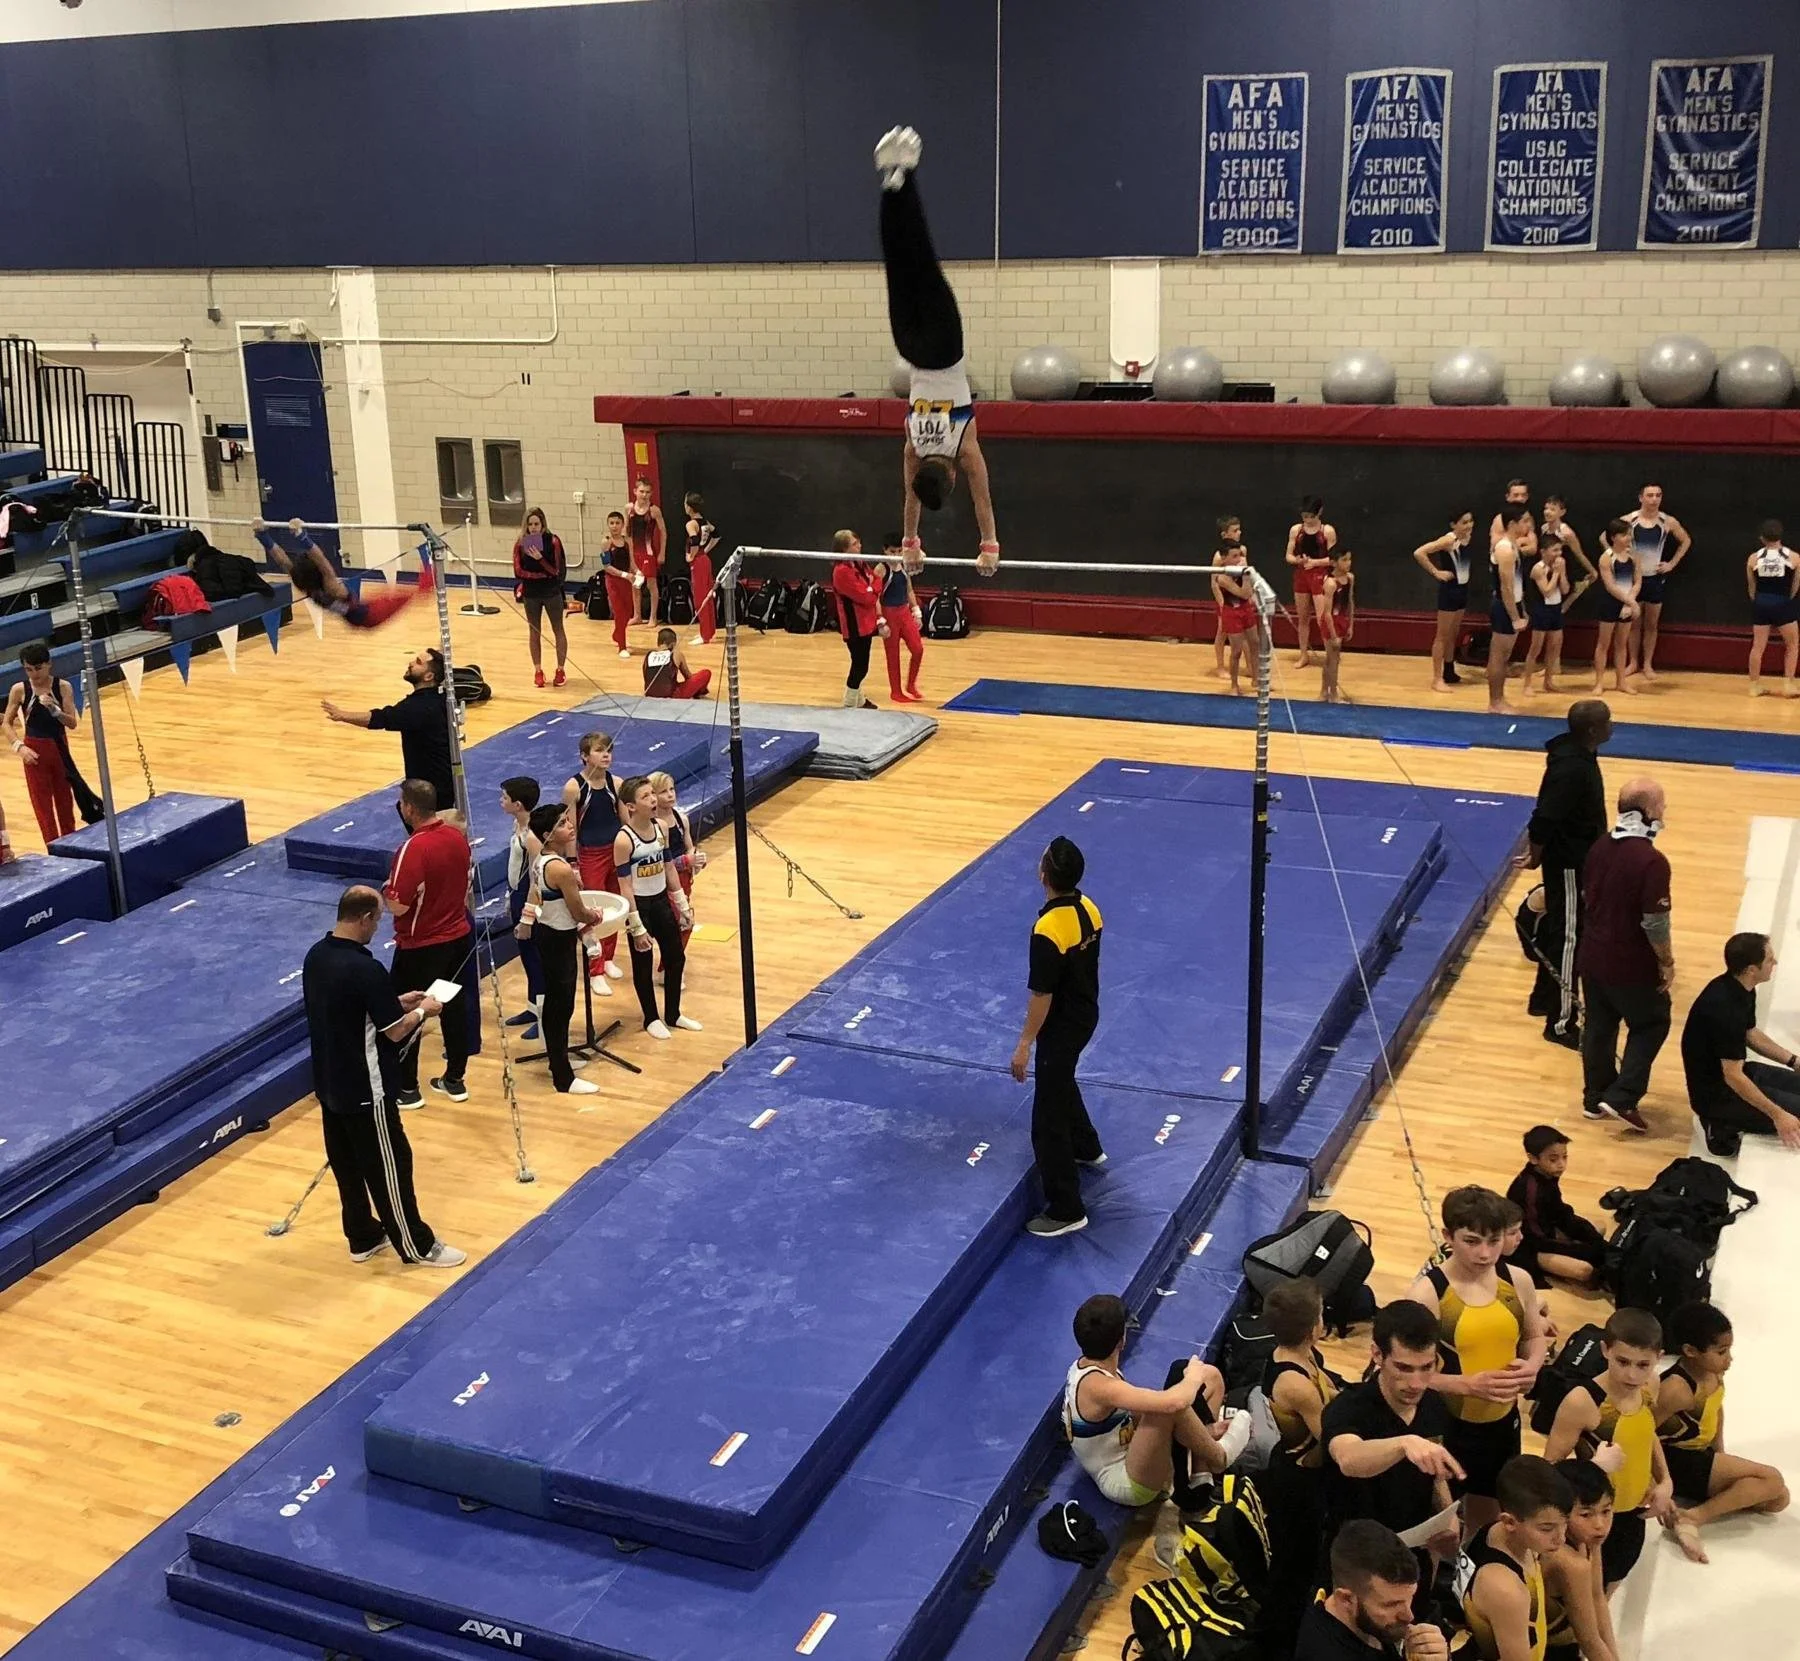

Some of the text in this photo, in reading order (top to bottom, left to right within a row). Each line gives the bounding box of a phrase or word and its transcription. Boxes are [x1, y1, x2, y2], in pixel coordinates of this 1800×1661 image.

[1378, 76, 1419, 100] AFA
[1534, 72, 1564, 92] AFA
[1686, 68, 1733, 92] AFA
[1228, 82, 1283, 108] AFA
[1526, 93, 1571, 112] MEN'S
[1684, 95, 1733, 114] MEN'S
[1232, 110, 1277, 129] MEN'S
[1376, 103, 1418, 121] MEN'S
[1499, 112, 1596, 131] GYMNASTICS
[1352, 122, 1441, 142] GYMNASTICS
[1656, 112, 1759, 133] GYMNASTICS
[1209, 131, 1300, 151] GYMNASTICS
[1526, 141, 1567, 158] USAG
[1221, 158, 1285, 178] SERVICE
[1364, 157, 1426, 175] SERVICE
[1498, 158, 1592, 178] COLLEGIATE
[1668, 151, 1740, 170] SERVICE
[1218, 179, 1288, 200] ACADEMY
[1360, 177, 1428, 196] ACADEMY
[1507, 179, 1580, 196] NATIONAL
[1665, 172, 1740, 192] ACADEMY
[1208, 200, 1294, 220] CHAMPIONS
[1351, 198, 1434, 216] CHAMPIONS
[1499, 198, 1587, 216] CHAMPIONS
[1655, 192, 1748, 211] CHAMPIONS
[1222, 227, 1279, 247] 2000
[1370, 228, 1412, 246] 2010
[1522, 227, 1559, 244] 2010
[1676, 225, 1719, 242] 2011
[918, 420, 944, 435] 701
[1297, 1075, 1314, 1094] AAI
[1153, 1123, 1174, 1145] AAI
[966, 1141, 990, 1167] AAI
[452, 1371, 490, 1407] AAI
[296, 1465, 336, 1502] AAI
[459, 1619, 523, 1648] AAI
